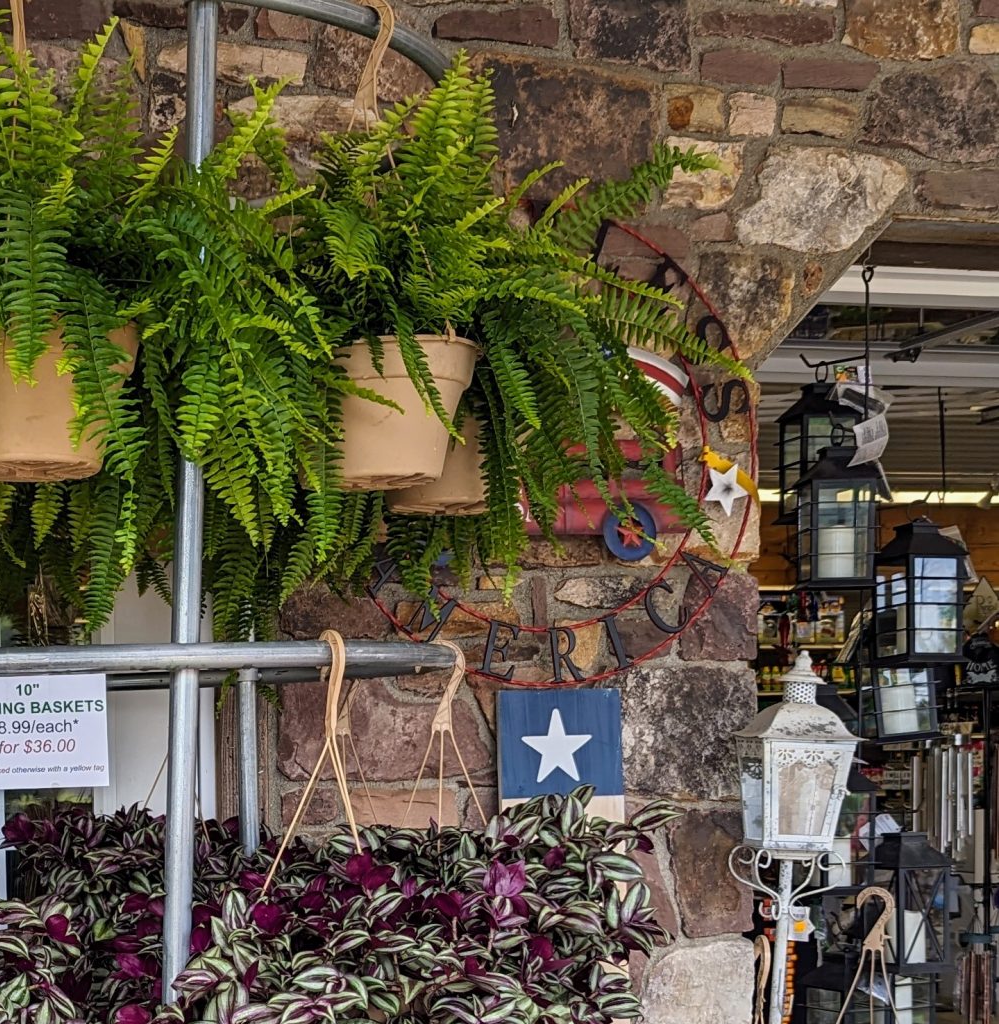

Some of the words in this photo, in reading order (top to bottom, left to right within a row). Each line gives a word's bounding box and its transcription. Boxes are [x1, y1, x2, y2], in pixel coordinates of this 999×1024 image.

[366, 551, 728, 684] AMERICA
[15, 683, 40, 696] 10"
[30, 700, 104, 713] BASKETS
[23, 738, 76, 754] $36.00
[12, 766, 46, 774] otherwise
[47, 765, 62, 773] with
[69, 764, 92, 774] yellow
[93, 764, 104, 773] tag
